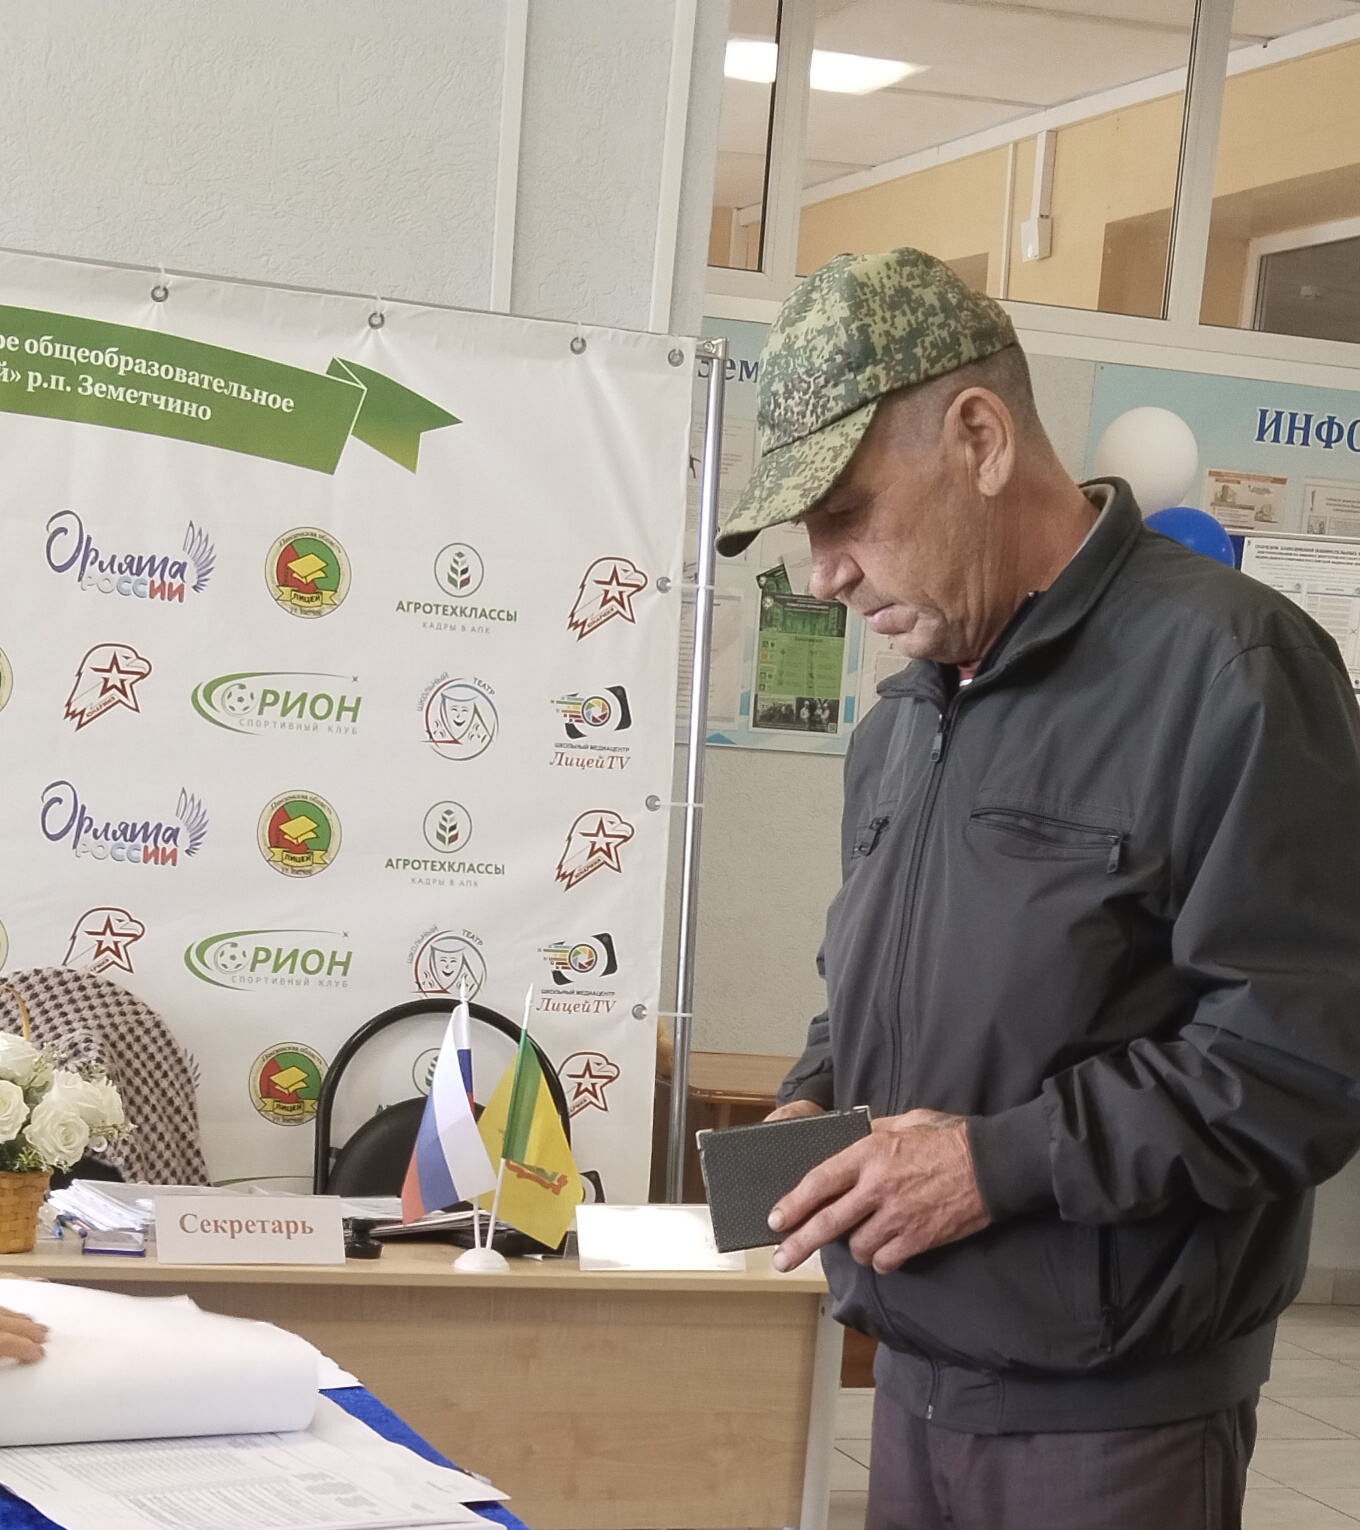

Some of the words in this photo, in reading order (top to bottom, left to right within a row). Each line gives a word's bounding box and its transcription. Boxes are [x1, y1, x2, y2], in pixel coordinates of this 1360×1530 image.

[24, 335, 296, 413] общеобразовательное
[28, 372, 71, 394] р.п.
[78, 375, 212, 421] Земетчино
[45, 509, 188, 582] Орлята
[395, 600, 517, 622] АГРОТЕХКЛАССЫ
[422, 622, 457, 631] КАДРЫ
[473, 677, 496, 696] ТЕАТР
[239, 718, 319, 732] СПОРТИВНЫЙ
[328, 725, 359, 735] КЛУБ
[40, 780, 180, 851] Орлята
[384, 857, 505, 876] АГРОТЕХКЛАССЫ
[411, 877, 445, 887] КАДРЫ
[458, 879, 480, 888] АПК
[461, 928, 484, 947] ТЕАТР
[231, 975, 310, 987] СПОРТИВНЫЙ
[318, 978, 349, 988] КЛУБ
[179, 1213, 314, 1239] Секретарь
